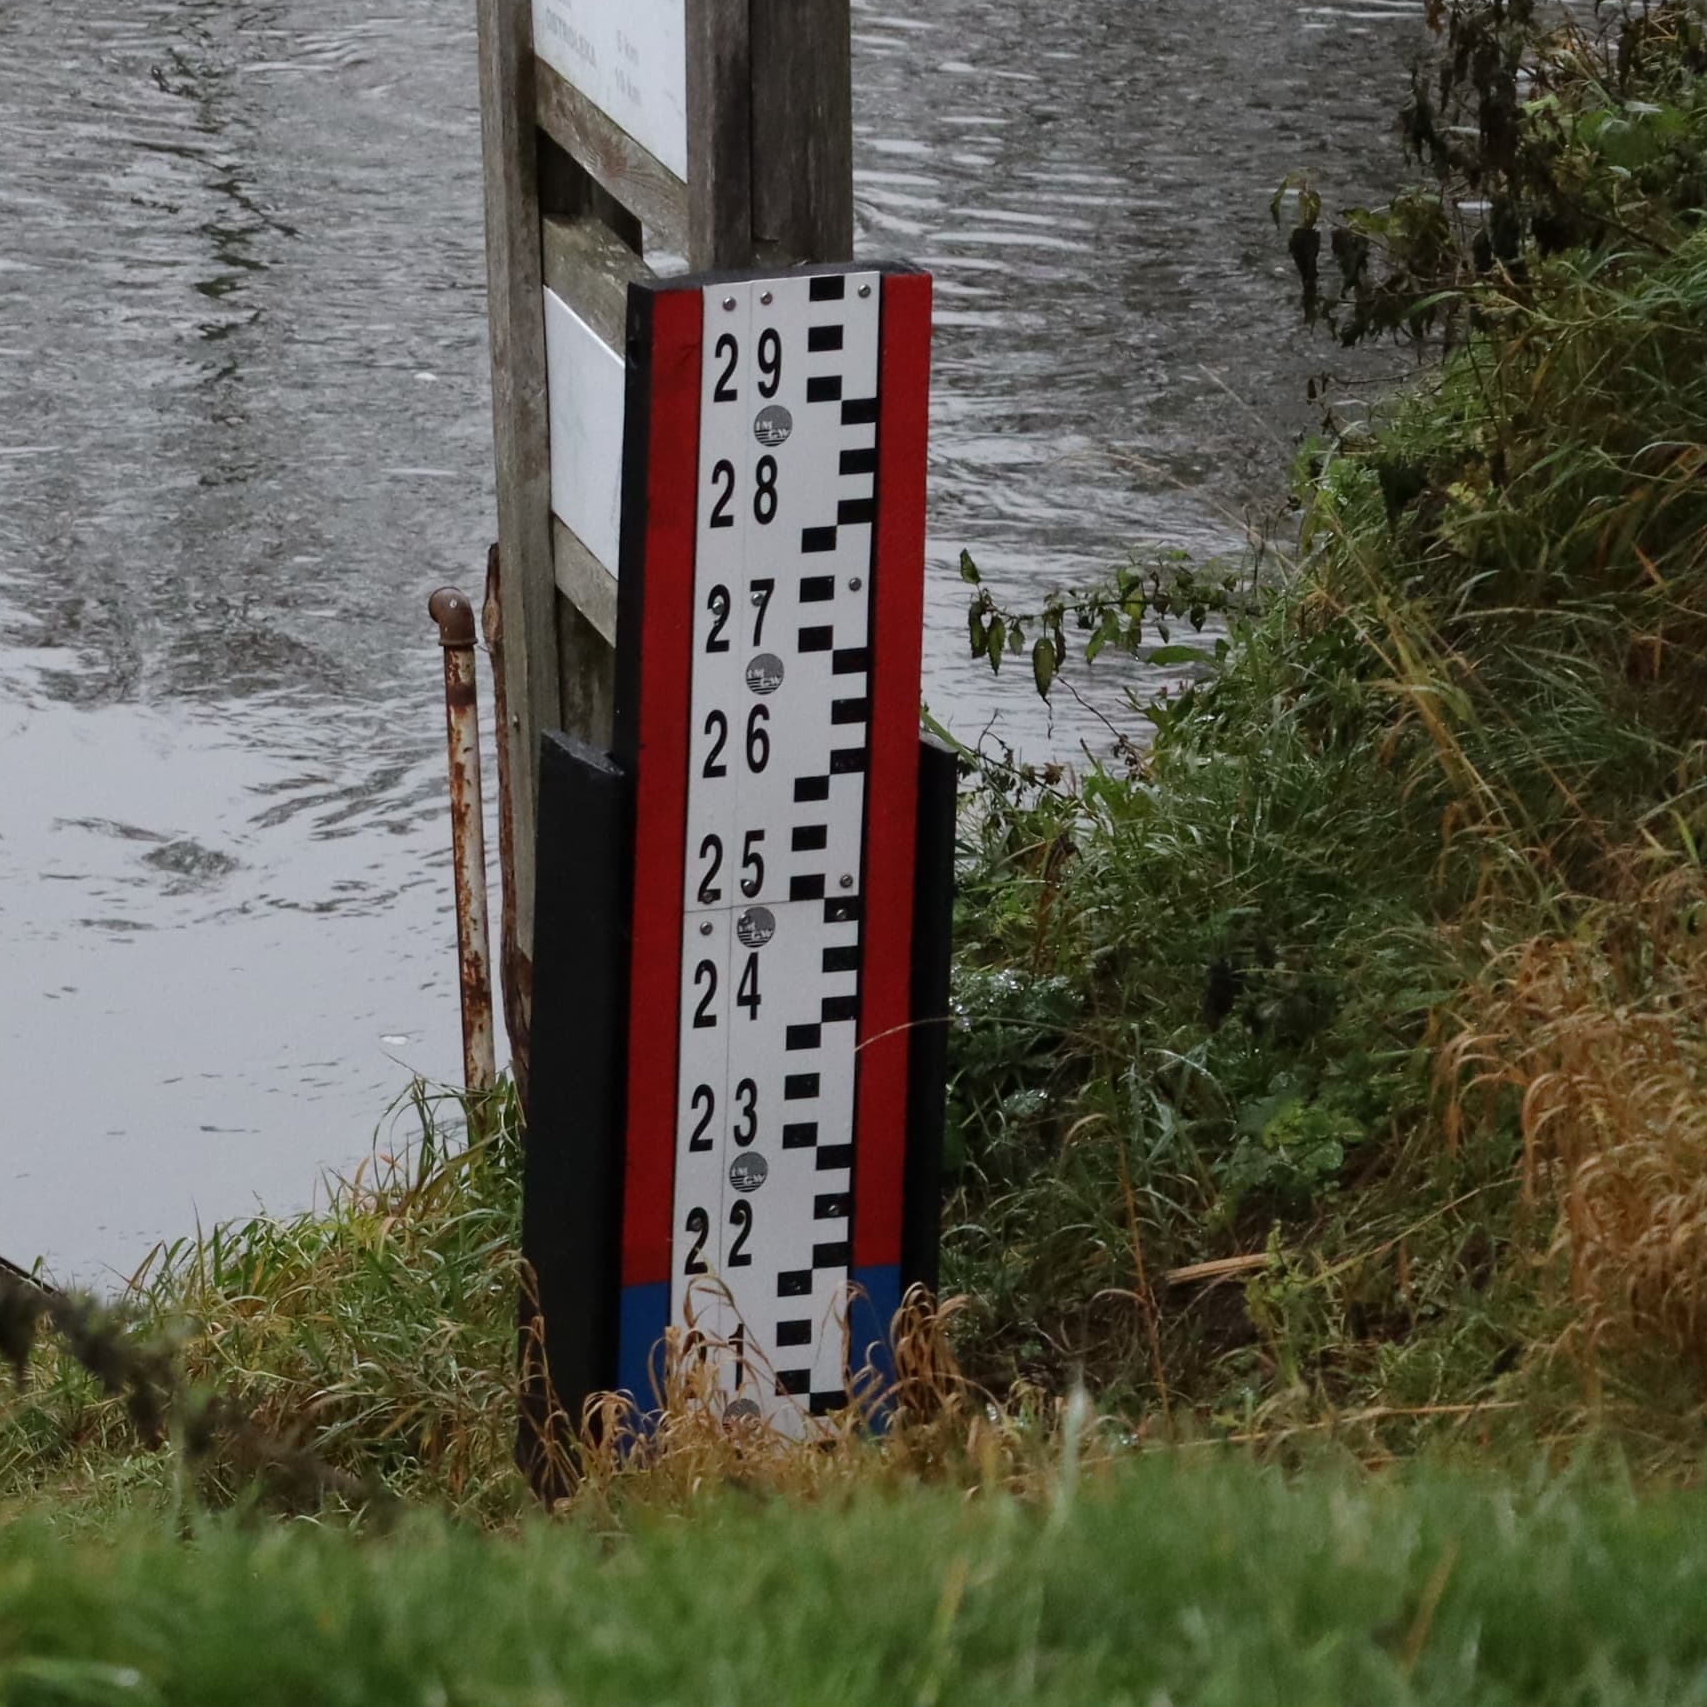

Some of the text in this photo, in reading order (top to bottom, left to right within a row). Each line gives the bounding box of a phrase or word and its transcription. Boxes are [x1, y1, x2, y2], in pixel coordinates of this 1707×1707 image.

[713, 327, 782, 403] 29
[709, 454, 778, 529] 28
[705, 577, 776, 655] 27
[702, 703, 770, 779] 26
[697, 829, 765, 905] 25
[692, 951, 762, 1029] 24
[688, 1077, 758, 1153] 23
[683, 1198, 753, 1276] 22
